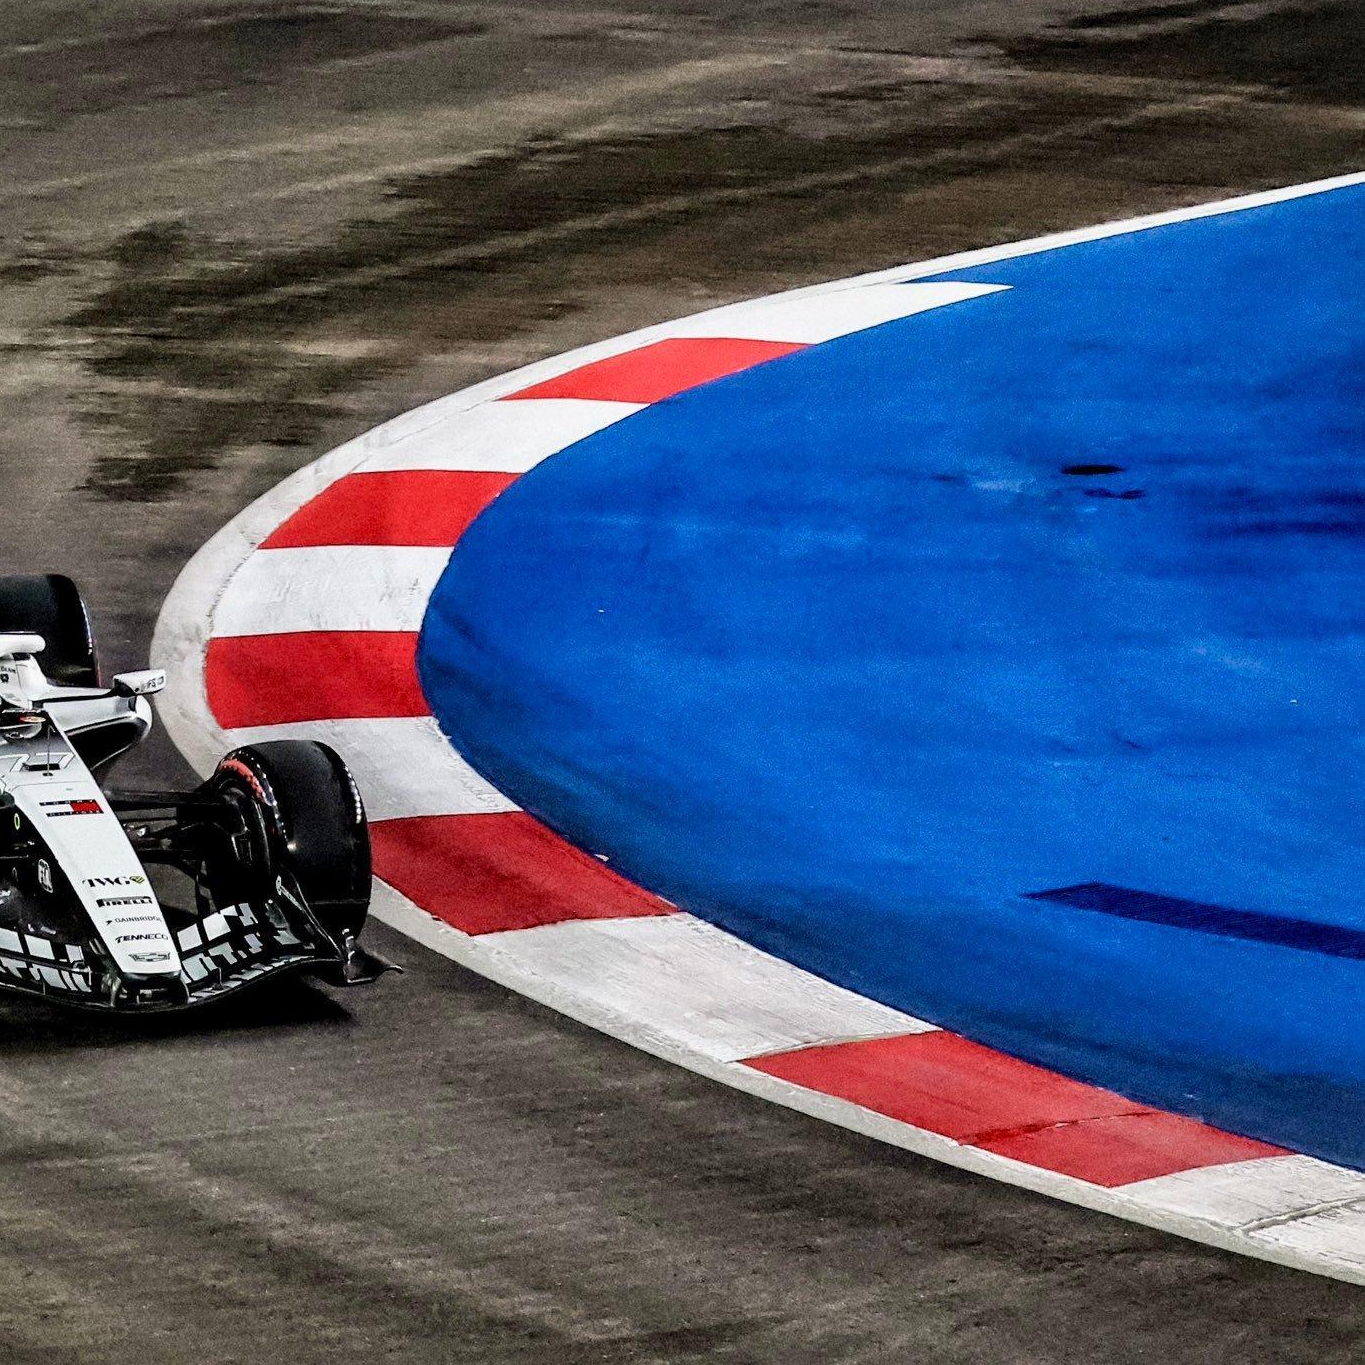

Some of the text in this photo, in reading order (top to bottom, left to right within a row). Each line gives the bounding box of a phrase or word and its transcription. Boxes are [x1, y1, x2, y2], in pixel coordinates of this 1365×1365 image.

[82, 876, 130, 887] TWG
[96, 896, 153, 908] PIRELLI
[115, 933, 169, 944] TENNECO
